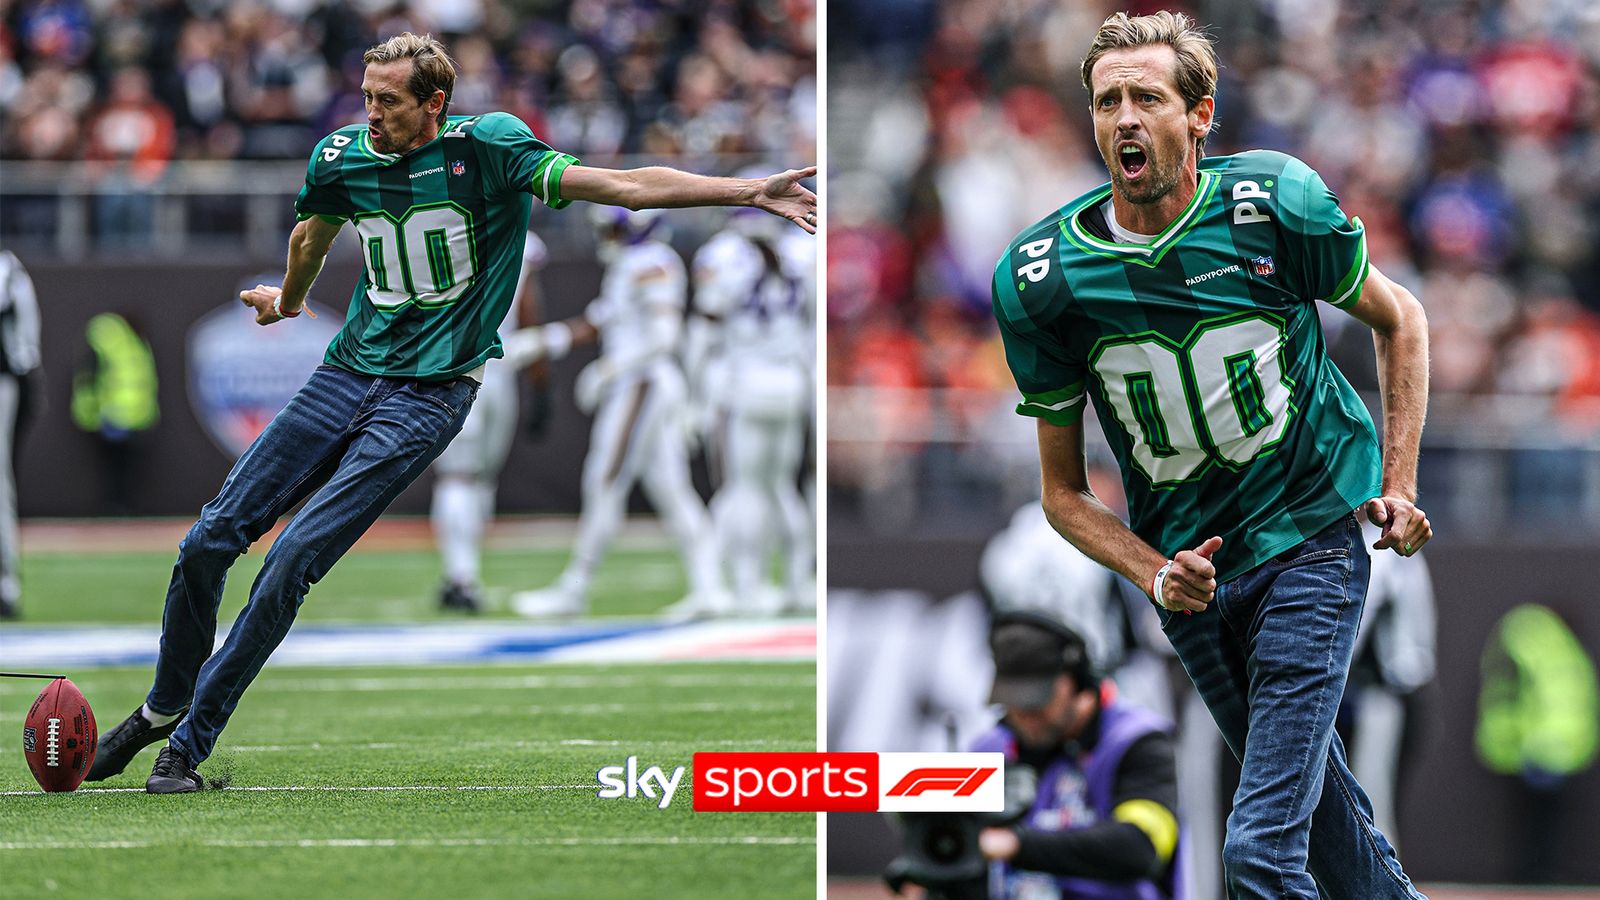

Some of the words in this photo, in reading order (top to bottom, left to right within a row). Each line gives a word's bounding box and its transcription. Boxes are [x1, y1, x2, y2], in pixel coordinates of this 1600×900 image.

[355, 202, 476, 312] 00
[1256, 264, 1274, 276] NFL
[1090, 312, 1298, 490] 00
